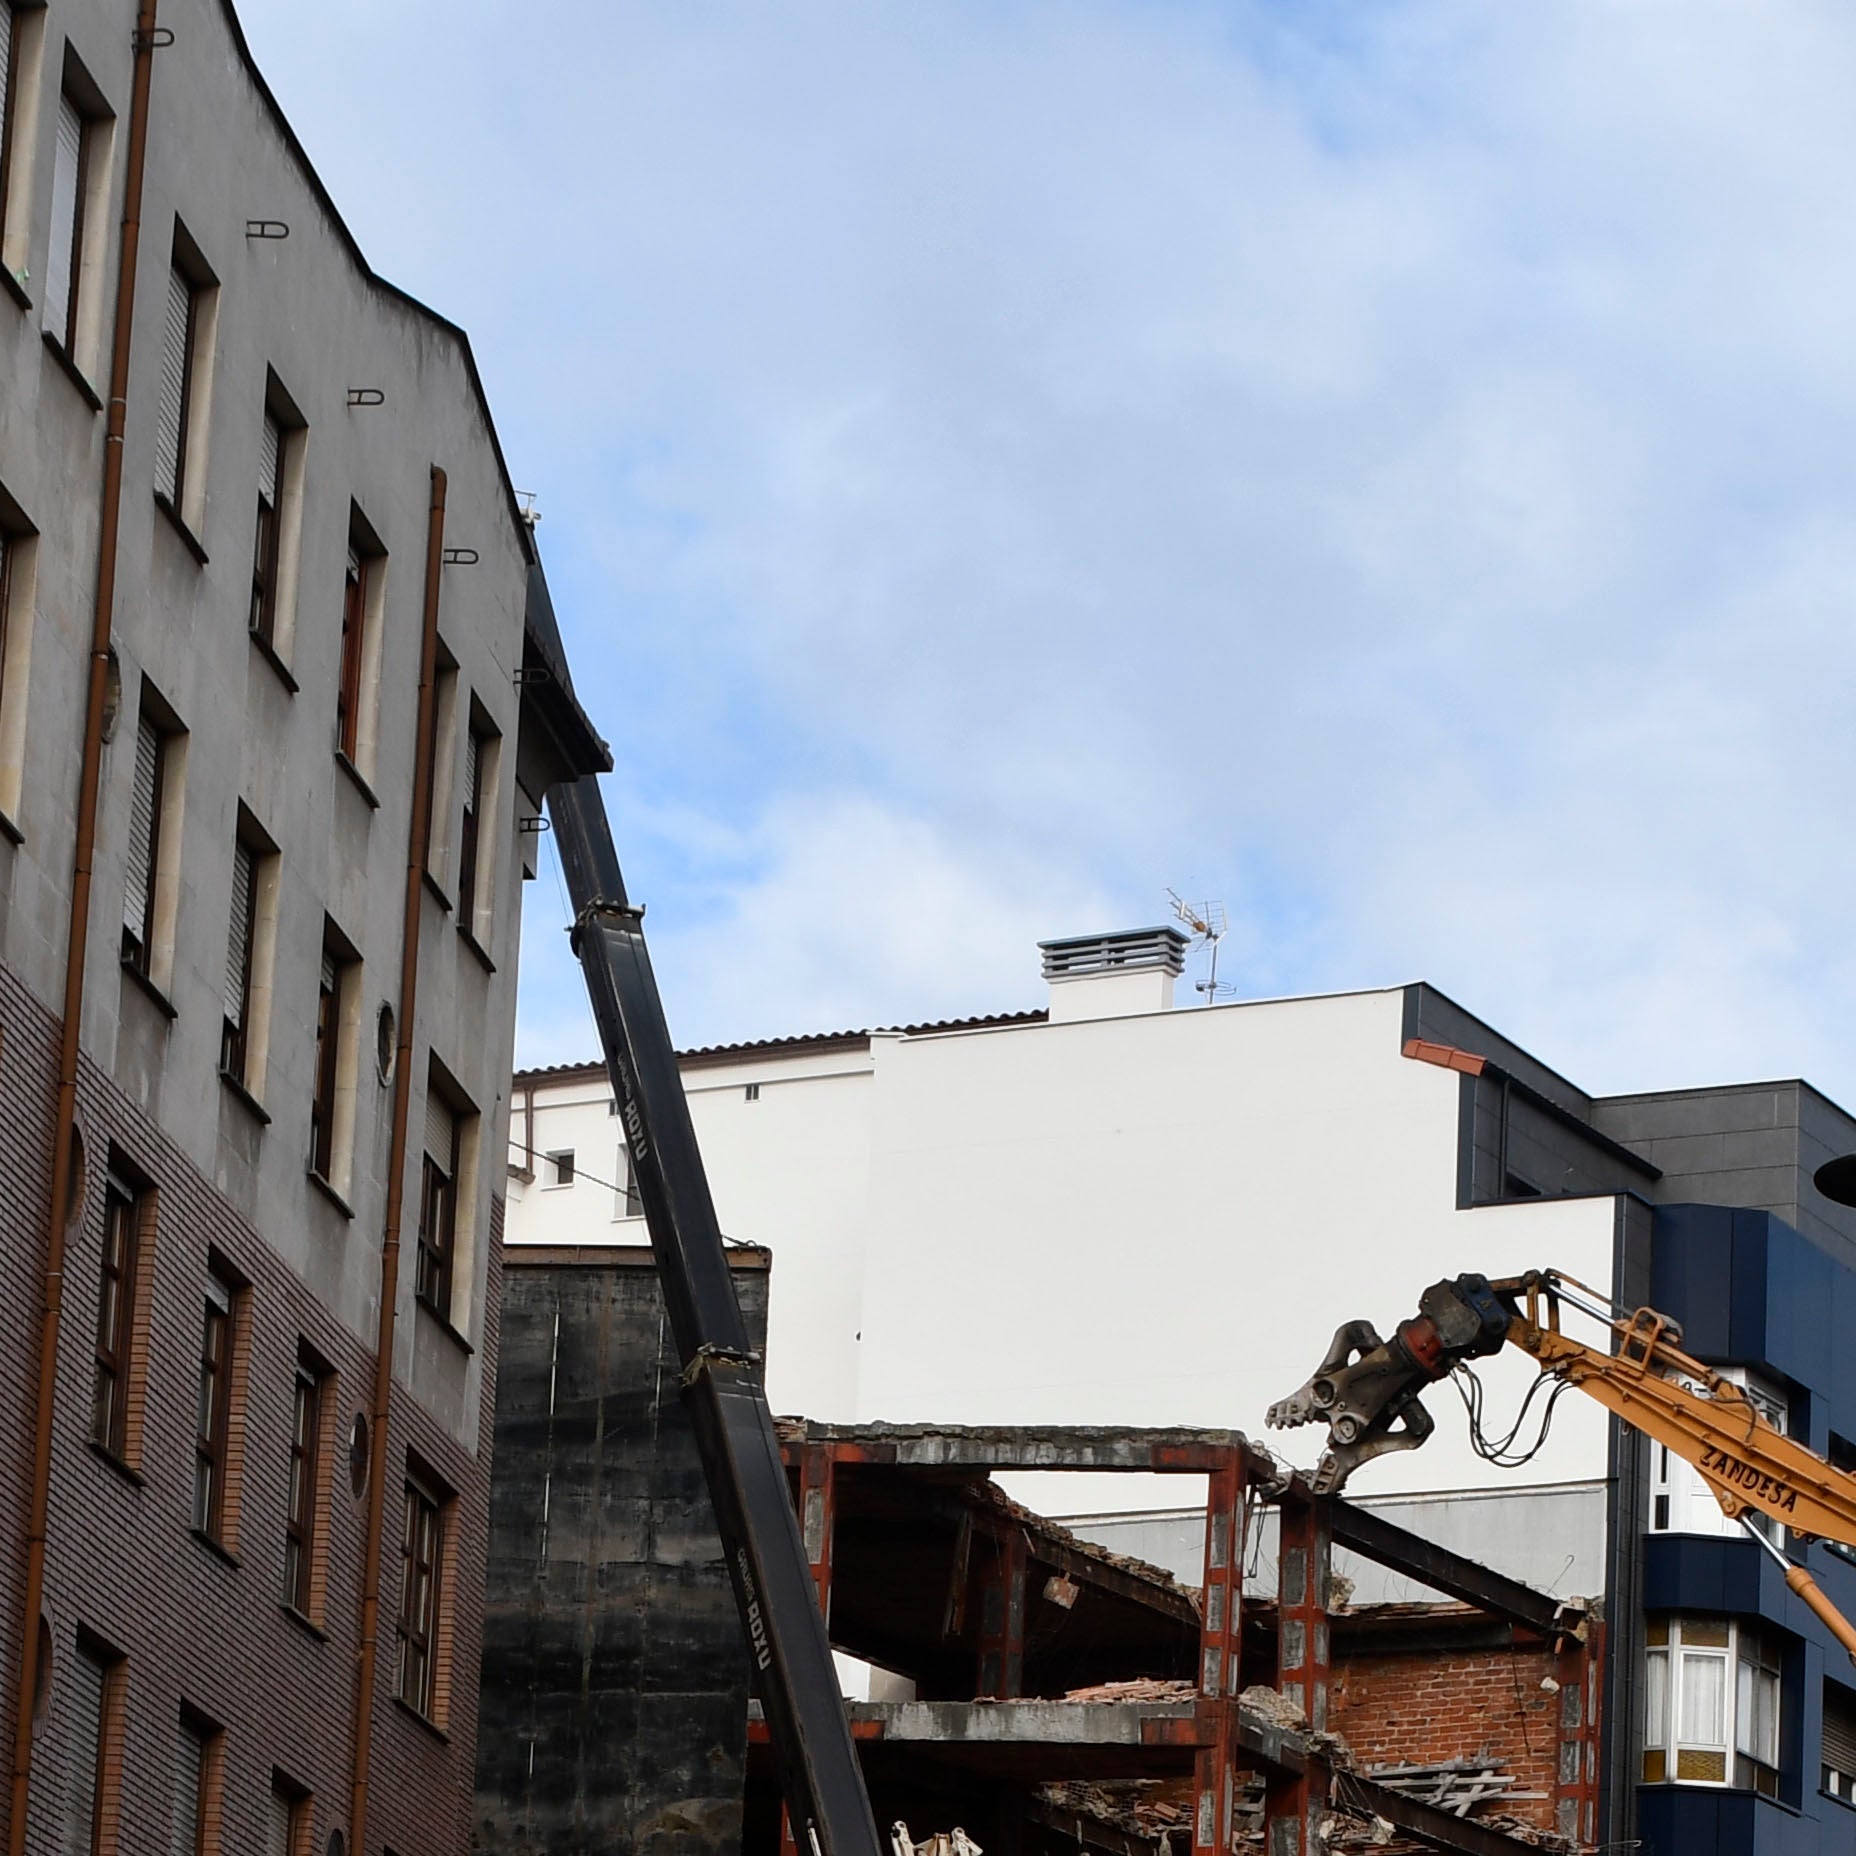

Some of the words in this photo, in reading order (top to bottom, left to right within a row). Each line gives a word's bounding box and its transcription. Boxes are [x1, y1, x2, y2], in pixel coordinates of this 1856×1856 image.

[625, 1098, 649, 1162] ROXU
[1700, 1444, 1799, 1513] ZANDESA
[747, 1598, 772, 1673] ROXU
